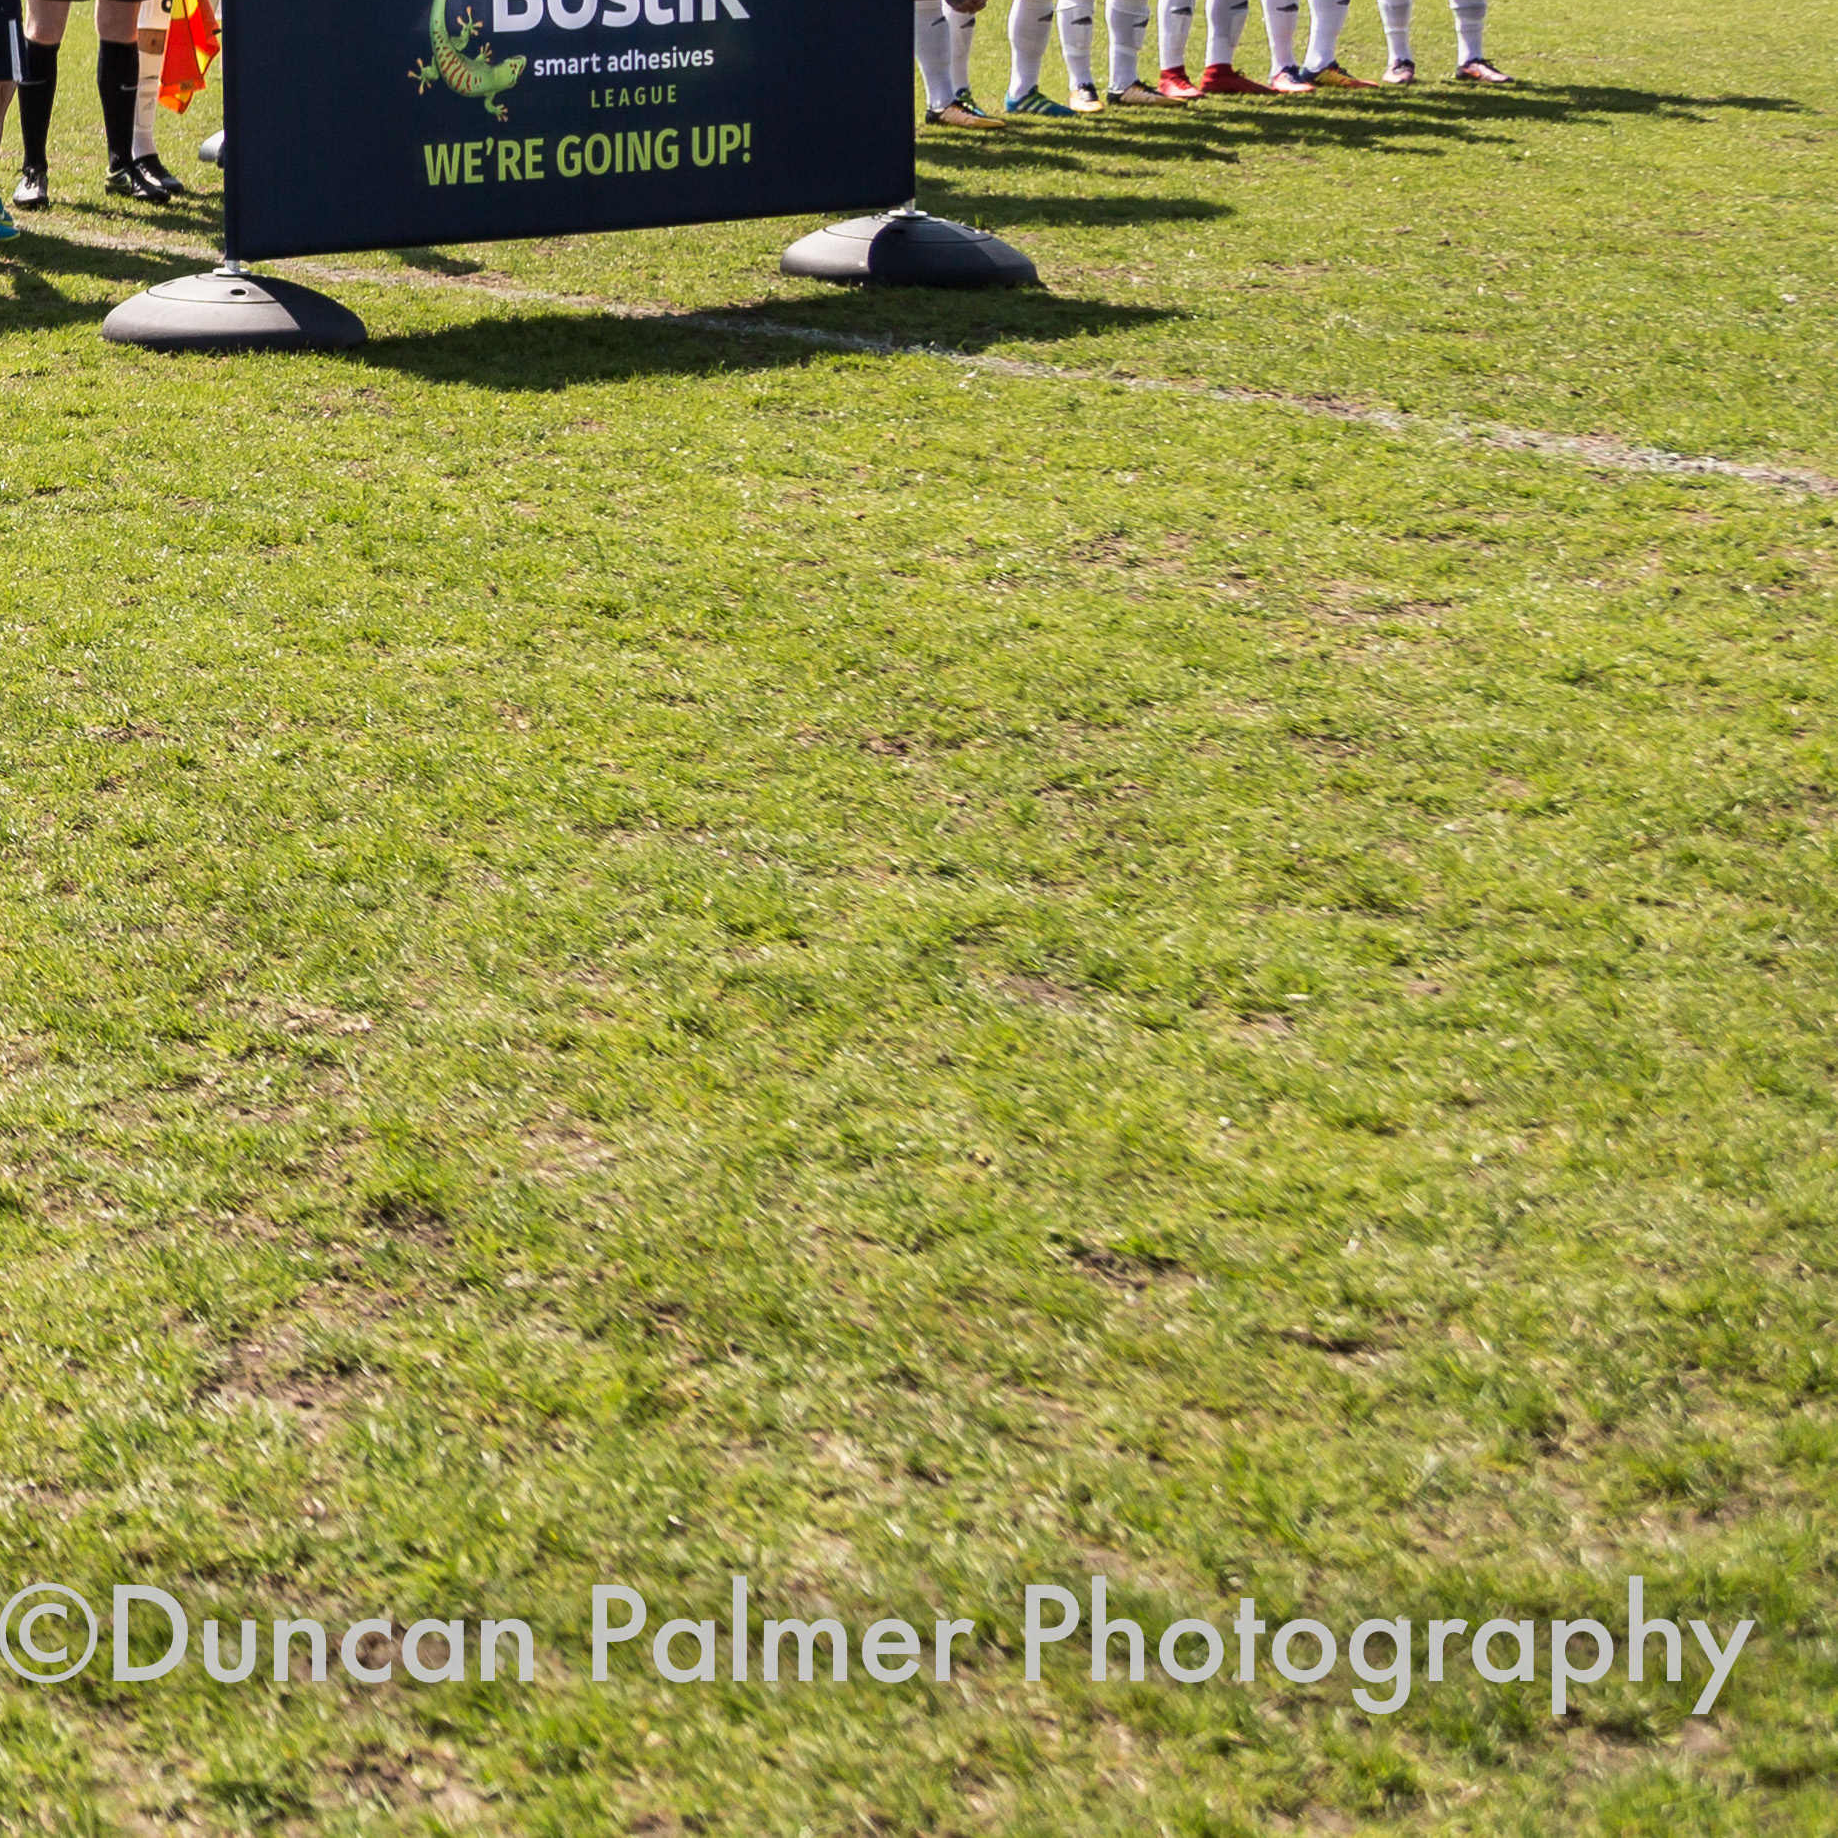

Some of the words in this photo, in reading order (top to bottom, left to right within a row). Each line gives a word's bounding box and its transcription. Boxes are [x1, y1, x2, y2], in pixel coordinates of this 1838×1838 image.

[533, 52, 601, 77] smart
[607, 46, 714, 74] adhesives
[591, 84, 677, 108] LEAGUE
[424, 137, 545, 186] WE'RE
[556, 128, 679, 178] GOING
[691, 122, 751, 167] UP!
